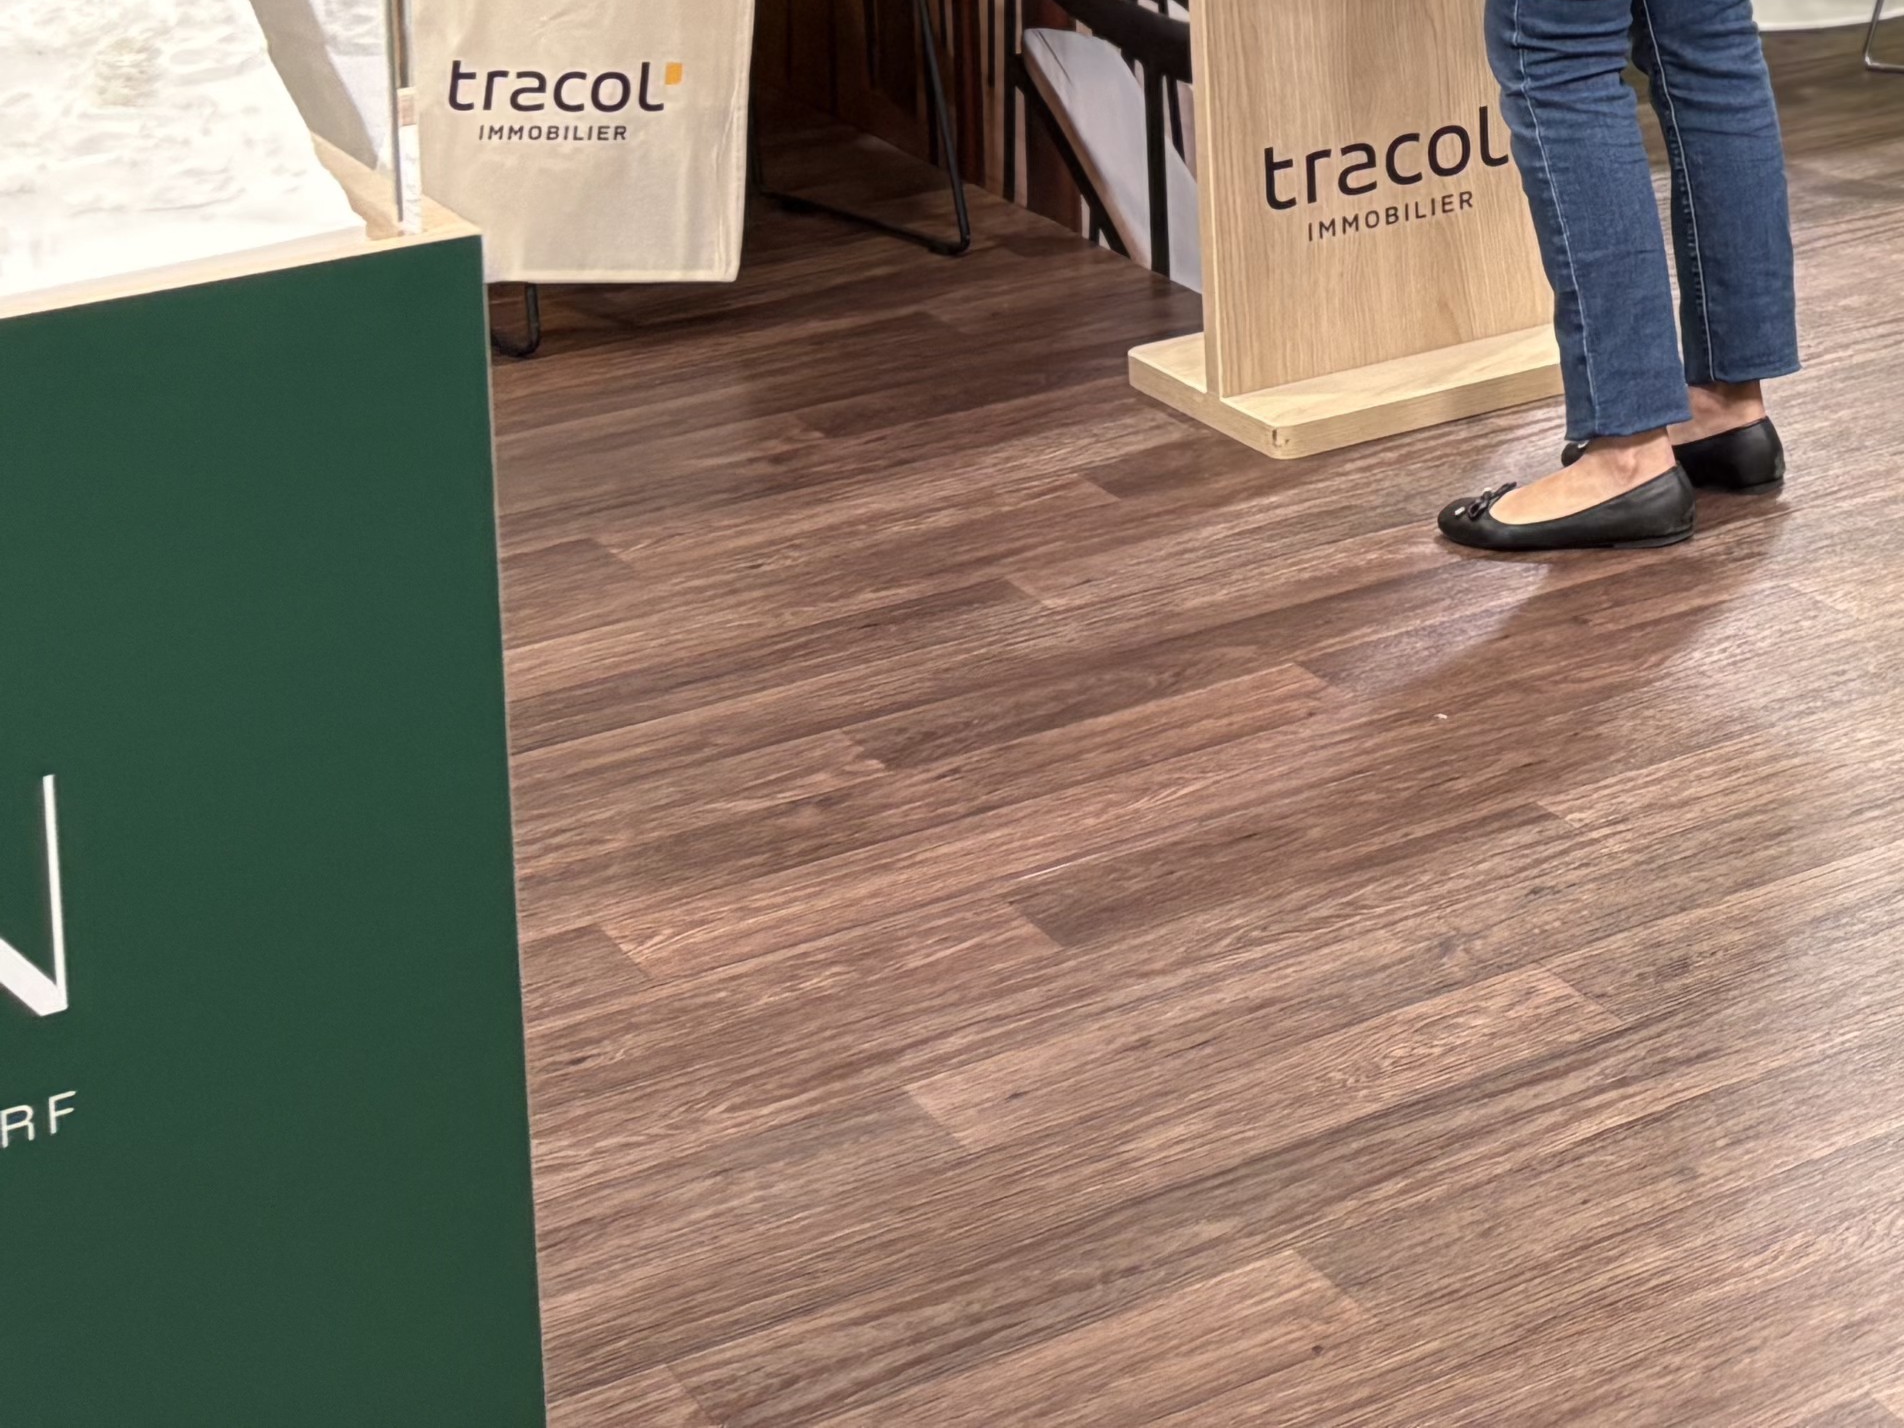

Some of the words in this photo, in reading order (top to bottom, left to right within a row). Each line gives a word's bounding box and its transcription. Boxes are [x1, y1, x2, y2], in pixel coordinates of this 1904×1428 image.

[448, 60, 664, 113] tracol
[478, 125, 627, 141] IMMOBILIER
[1264, 105, 1509, 210] tracol
[1308, 190, 1474, 242] IMMOBILIER
